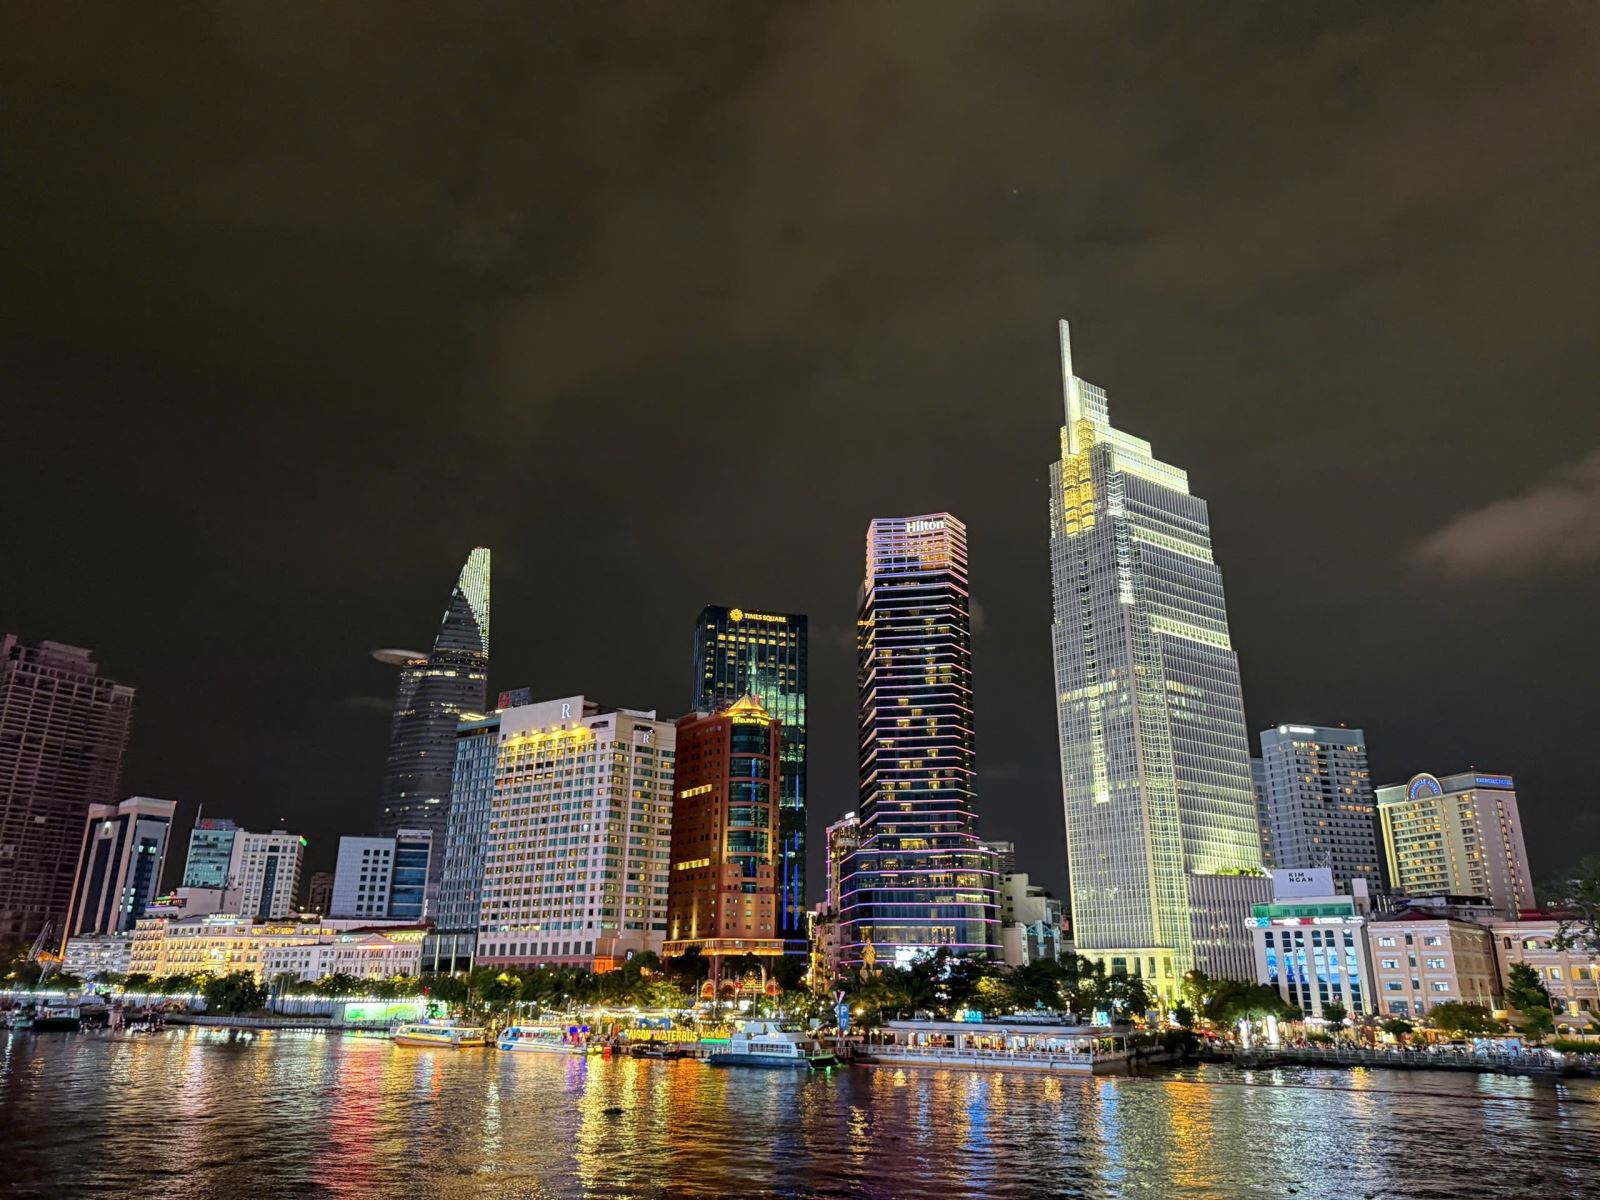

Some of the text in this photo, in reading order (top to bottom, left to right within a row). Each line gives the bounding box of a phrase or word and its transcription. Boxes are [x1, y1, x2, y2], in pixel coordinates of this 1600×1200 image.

[906, 520, 945, 533] Hilton
[744, 612, 787, 623] TIMES SQUARE
[561, 703, 571, 719] R
[653, 1029, 698, 1042] WATERBUS
